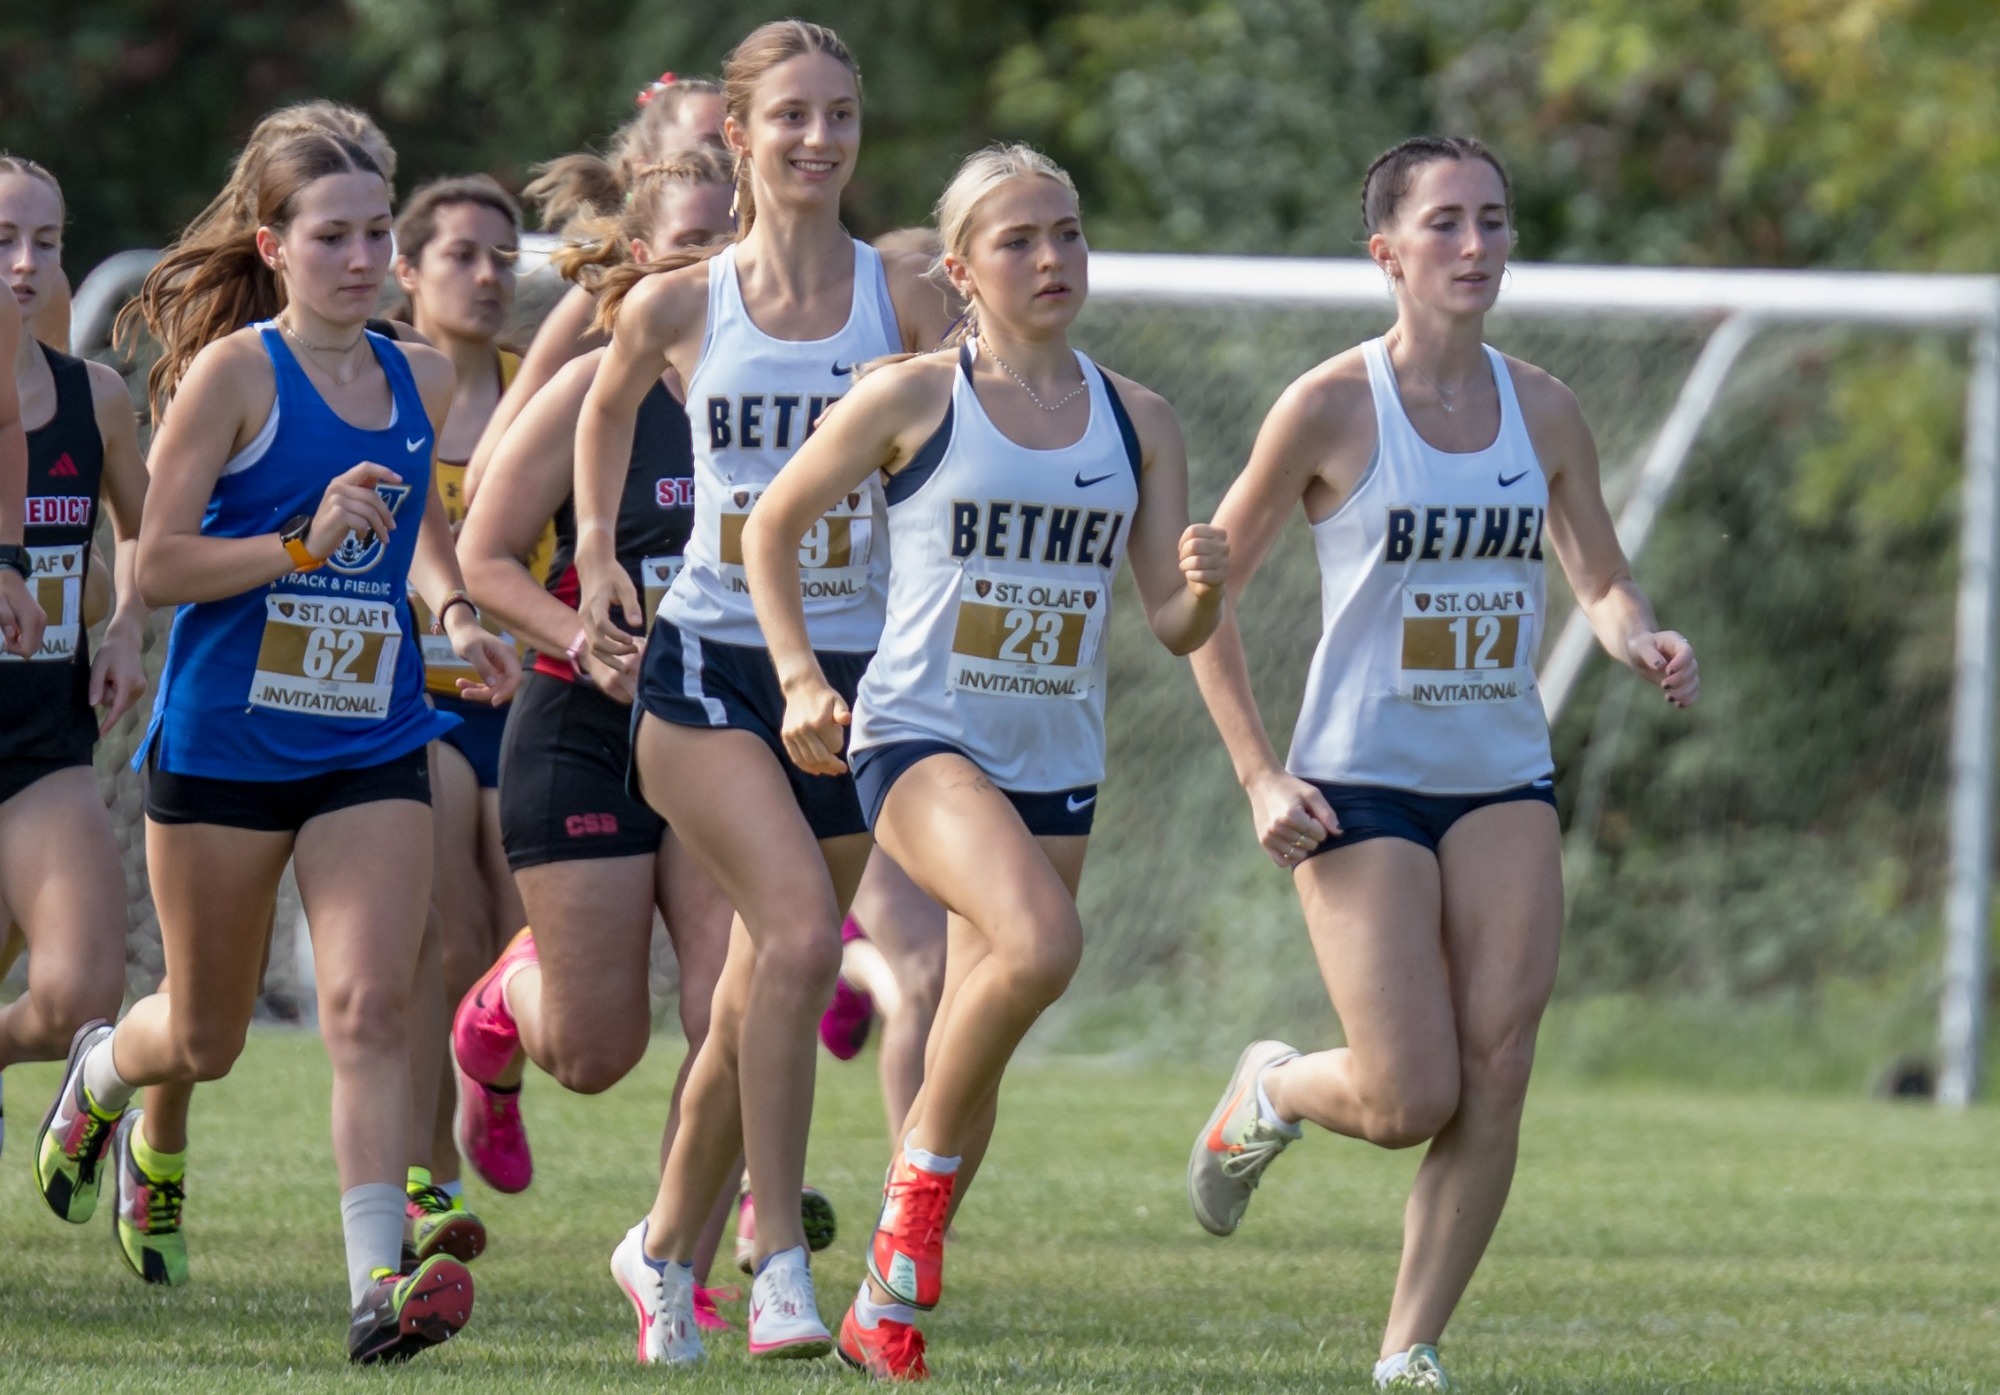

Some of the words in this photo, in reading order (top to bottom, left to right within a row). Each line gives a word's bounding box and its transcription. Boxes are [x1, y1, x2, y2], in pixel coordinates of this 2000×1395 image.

[24, 496, 91, 525] EDICT
[798, 517, 829, 568] 9
[950, 498, 1125, 571] BETHEL
[330, 577, 340, 590] &
[994, 582, 1023, 604] ST.
[1028, 585, 1081, 609] OLAF
[298, 602, 325, 623] ST.
[329, 605, 380, 628] OLAF
[1434, 592, 1462, 612] ST.
[1465, 591, 1514, 611] OLAF
[998, 608, 1064, 664] 23
[1449, 615, 1501, 669] 12
[302, 628, 365, 682] 62
[959, 668, 1076, 696] INVITATIONAL
[1412, 682, 1518, 701] INVITATIONAL
[262, 685, 378, 714] INVITATIONAL
